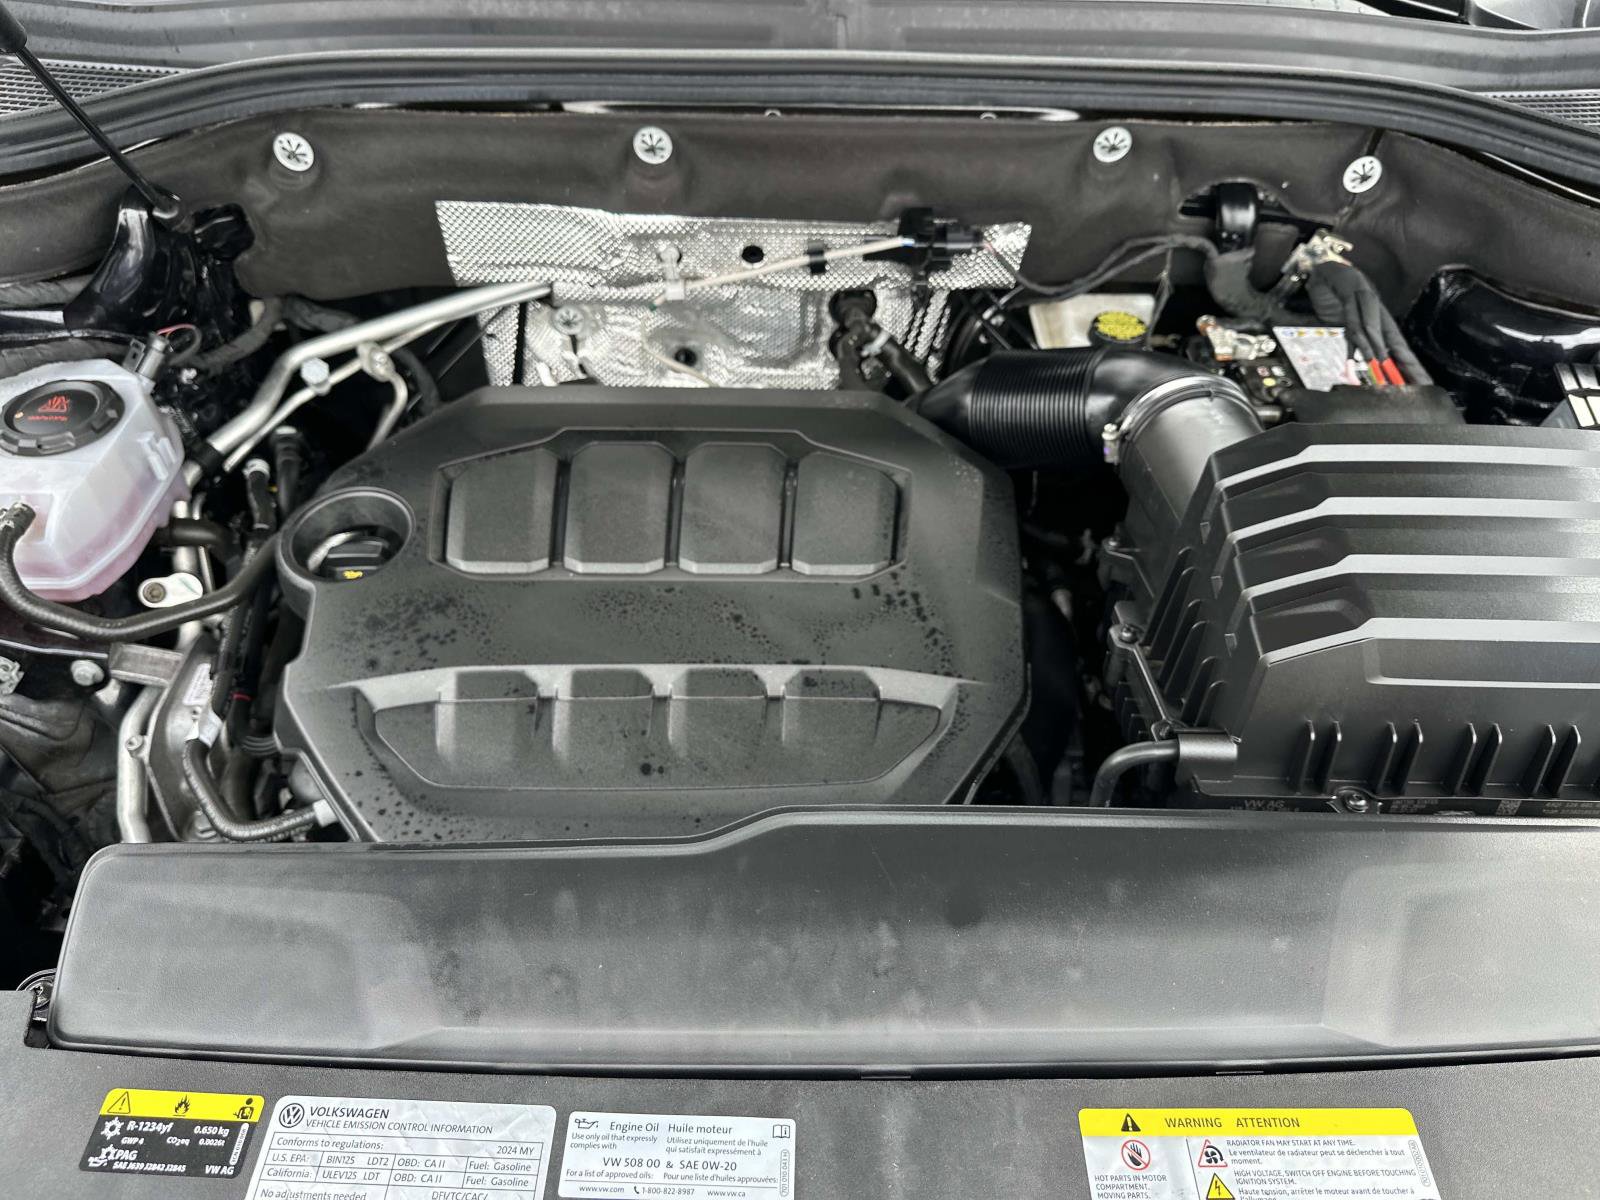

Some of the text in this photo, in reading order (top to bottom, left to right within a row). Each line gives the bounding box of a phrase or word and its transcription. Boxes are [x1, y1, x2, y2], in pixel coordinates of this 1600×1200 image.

[309, 1105, 390, 1120] VOLKSWAGEN
[127, 1120, 174, 1135] R-1234yf
[305, 1119, 494, 1134] VEHICLE EMISSION CONTROL INFORMATION
[609, 1121, 733, 1135] Engine Oil Huile moteur
[1164, 1117, 1301, 1129] WARNING ATTENTION
[193, 1125, 230, 1138] 0.650 kg
[121, 1136, 139, 1145] GWP
[276, 1136, 384, 1151] Conforms to regulations:
[571, 1132, 658, 1144] Use only oil that expressly
[666, 1136, 692, 1145] Utilisez
[693, 1137, 736, 1147] uniquement
[737, 1138, 746, 1147] de
[1226, 1139, 1260, 1147] RADIATOR
[1262, 1139, 1275, 1147] FAN
[1276, 1139, 1290, 1147] MAY
[1291, 1139, 1311, 1147] START
[1313, 1139, 1321, 1147] AT
[1322, 1139, 1336, 1147] ANY
[496, 1145, 535, 1156] 2024 MY
[569, 1142, 617, 1151] complies with
[678, 1146, 706, 1154] satisfait
[115, 1149, 139, 1161] PAG
[271, 1152, 288, 1162] U.S.
[1228, 1149, 1238, 1157] Le
[1238, 1149, 1275, 1157] ventilateur
[1276, 1149, 1286, 1157] de
[1287, 1149, 1318, 1157] radiateur
[1320, 1149, 1336, 1158] peut
[1389, 1149, 1405, 1157] tout
[112, 1161, 129, 1170] SAE
[366, 1156, 390, 1166] LDT2
[396, 1158, 420, 1168] OBD:
[468, 1161, 532, 1172] Fuel: Gasoline
[602, 1157, 738, 1171] VW 508 00 & SAE 0W-20
[204, 1164, 235, 1176] VW AG
[266, 1167, 313, 1179] California:
[565, 1169, 578, 1177] For
[605, 1171, 638, 1179] approved
[1233, 1169, 1417, 1178] HIGH VOLTAGE, SWITCH OFF ENGINE BEFORE TOUCHING
[362, 1171, 380, 1181] LDT
[393, 1172, 417, 1183] OBD:
[465, 1175, 529, 1188] Fuel: Gasoline
[1094, 1174, 1167, 1182] HOT PARTS IN MOTOR
[1095, 1183, 1151, 1191] COMPARTMENT.
[1238, 1187, 1260, 1196] Haute
[1371, 1187, 1381, 1195] de
[260, 1187, 274, 1198] No
[275, 1189, 332, 1200] adjustments
[1097, 1192, 1126, 1200] MOVING
